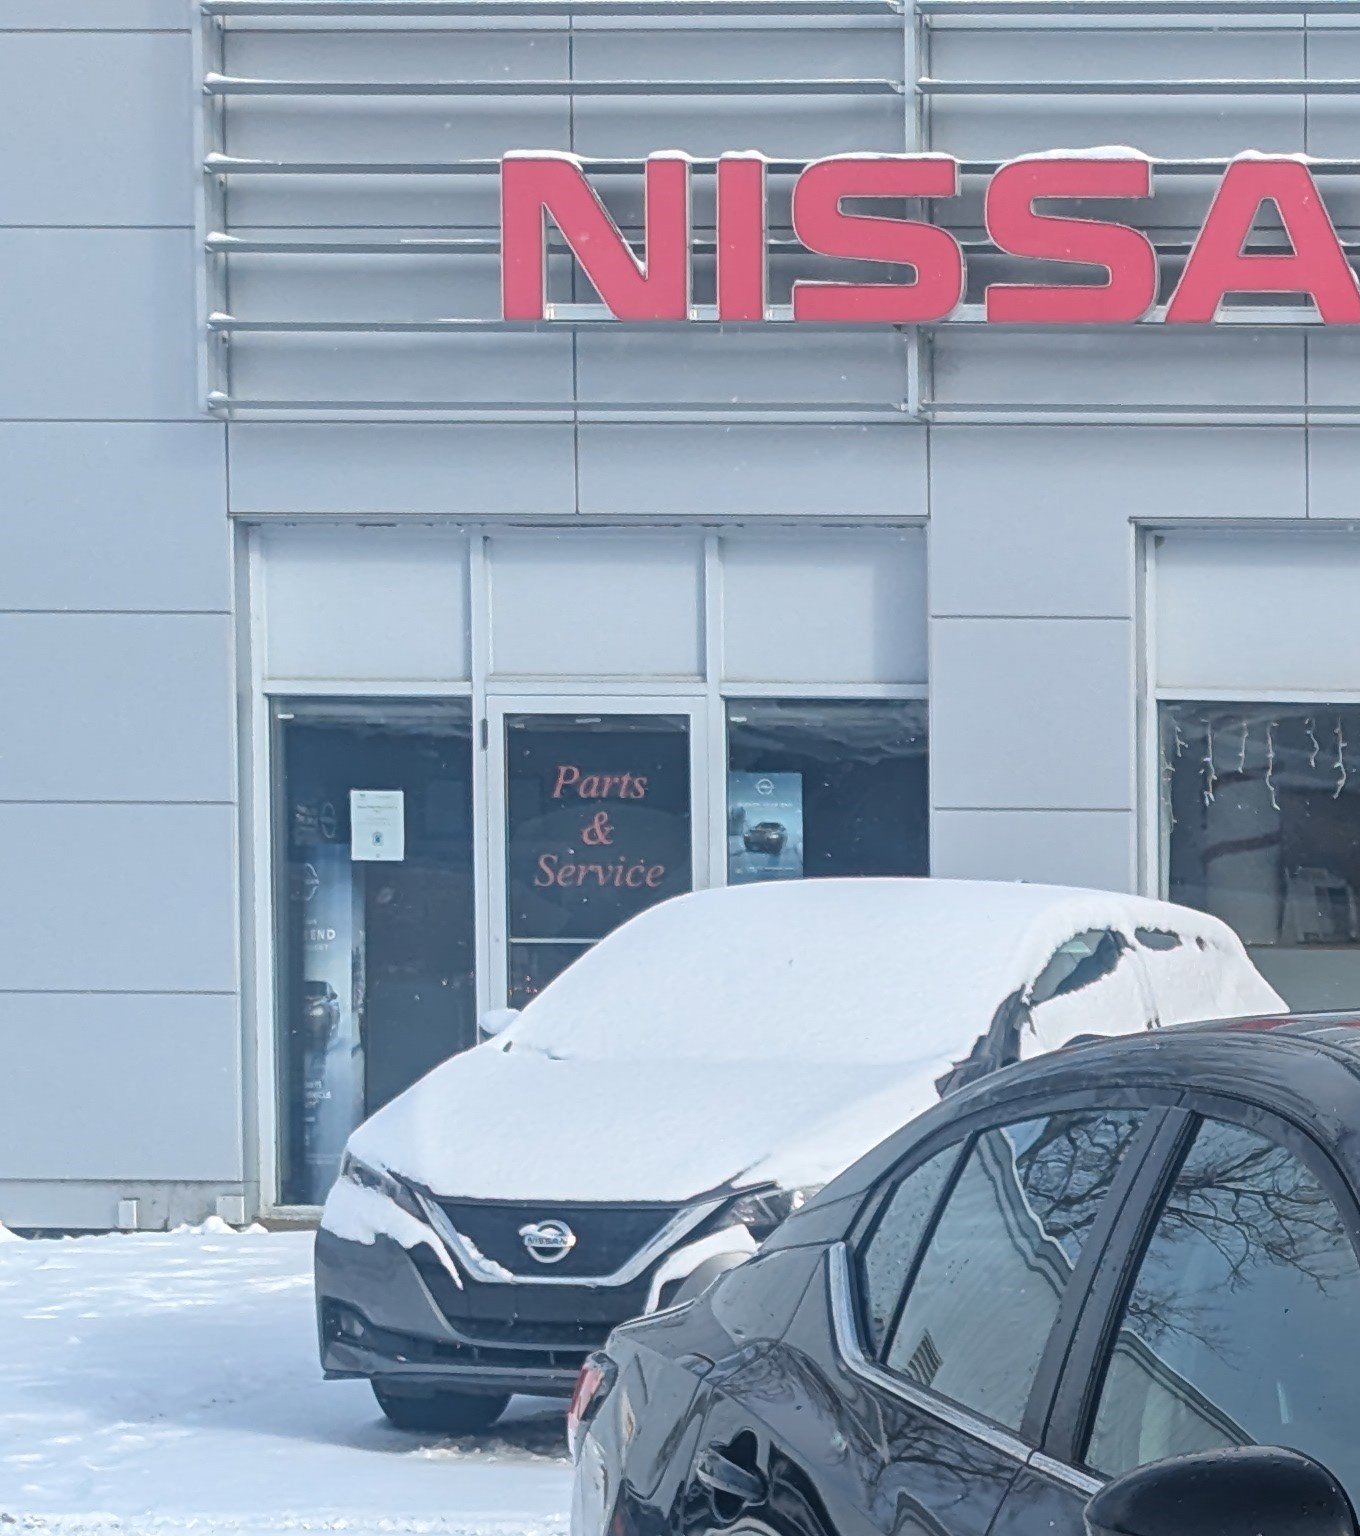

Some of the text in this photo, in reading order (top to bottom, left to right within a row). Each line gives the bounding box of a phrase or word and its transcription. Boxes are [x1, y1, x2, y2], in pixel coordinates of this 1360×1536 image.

[551, 765, 648, 799] Parts
[582, 811, 615, 846] &
[534, 854, 666, 888] Service
